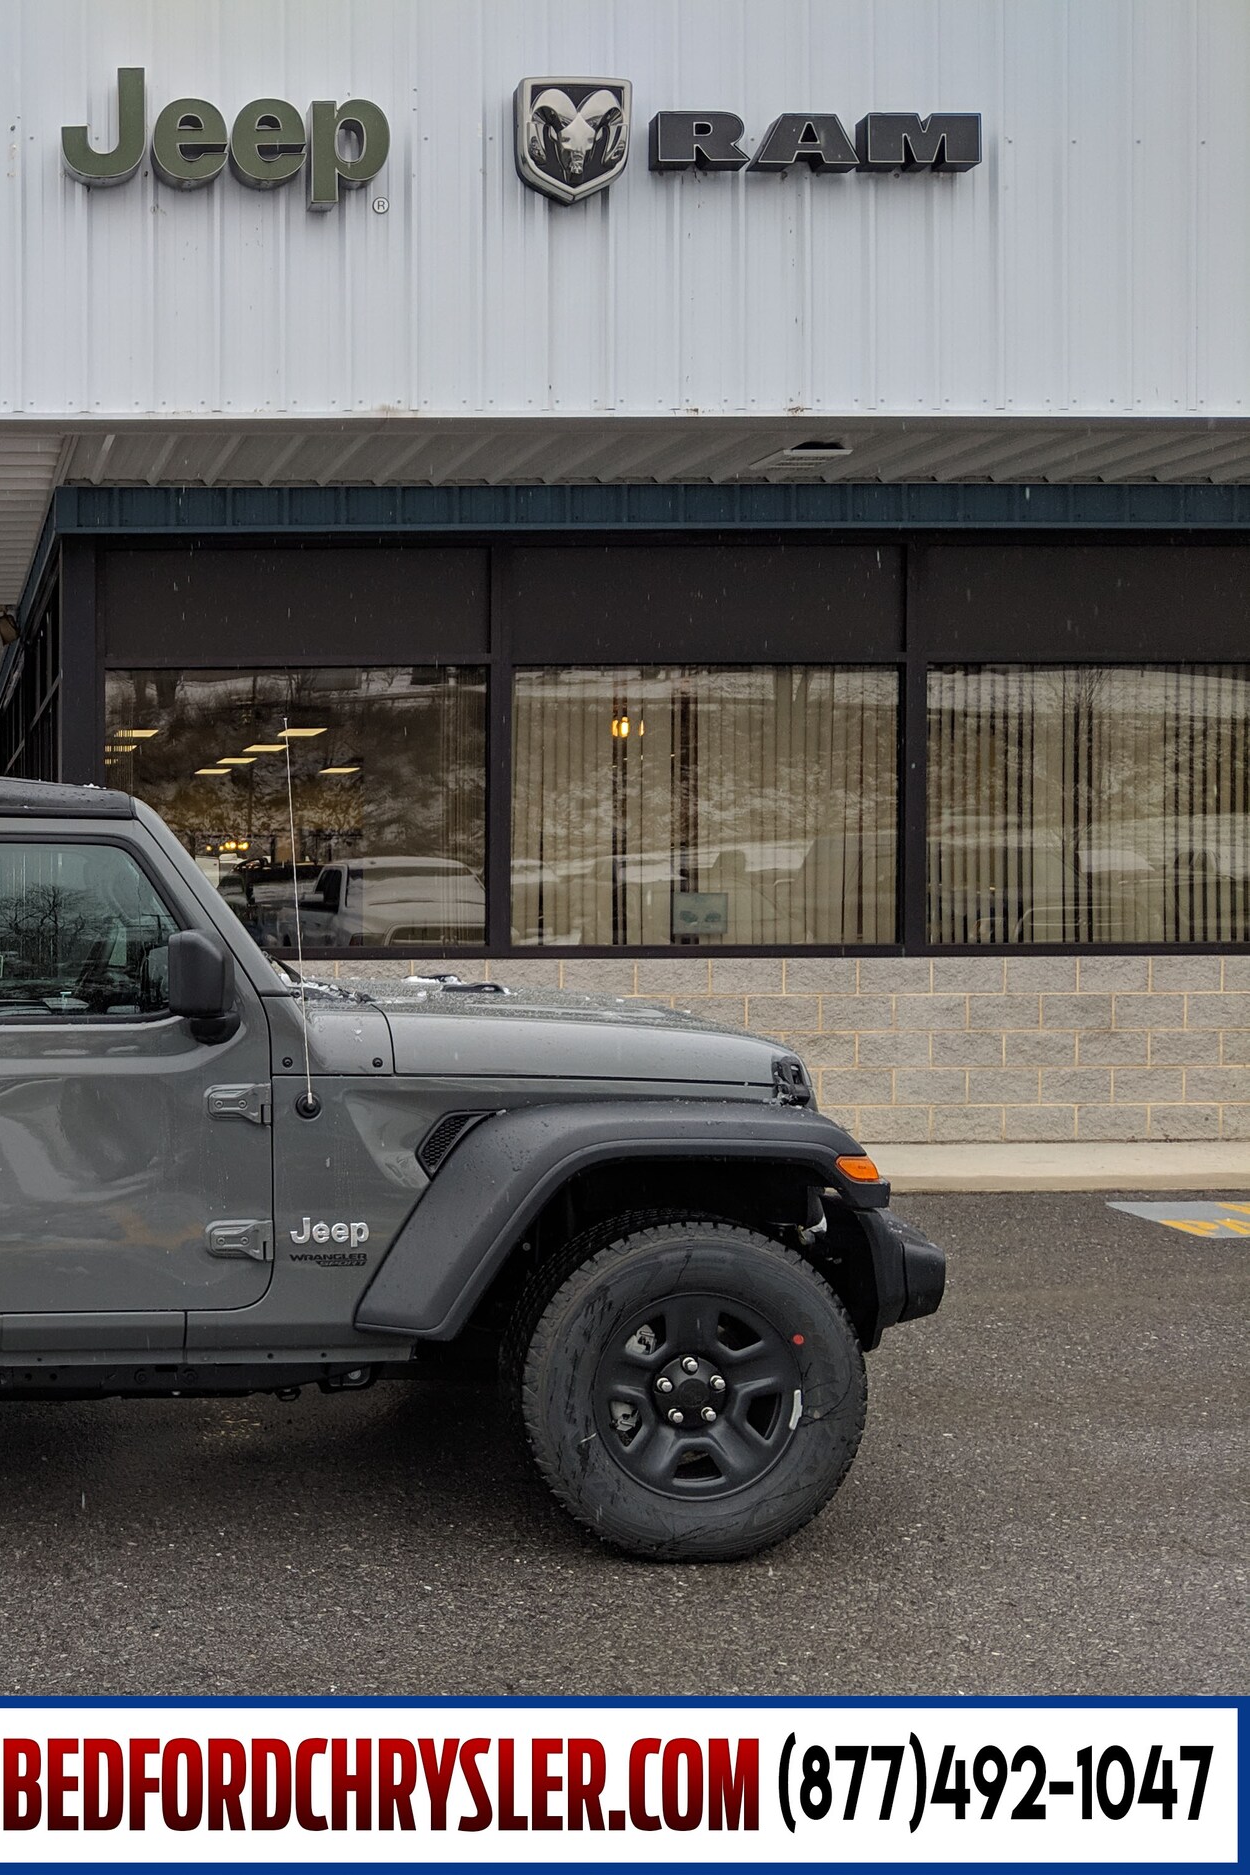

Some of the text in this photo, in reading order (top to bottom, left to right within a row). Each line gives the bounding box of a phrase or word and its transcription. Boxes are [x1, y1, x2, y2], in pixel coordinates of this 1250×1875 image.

[61, 66, 391, 211] Jeep
[649, 111, 982, 172] RAM
[290, 1217, 370, 1248] Jeep
[289, 1253, 367, 1262] WRANGLER
